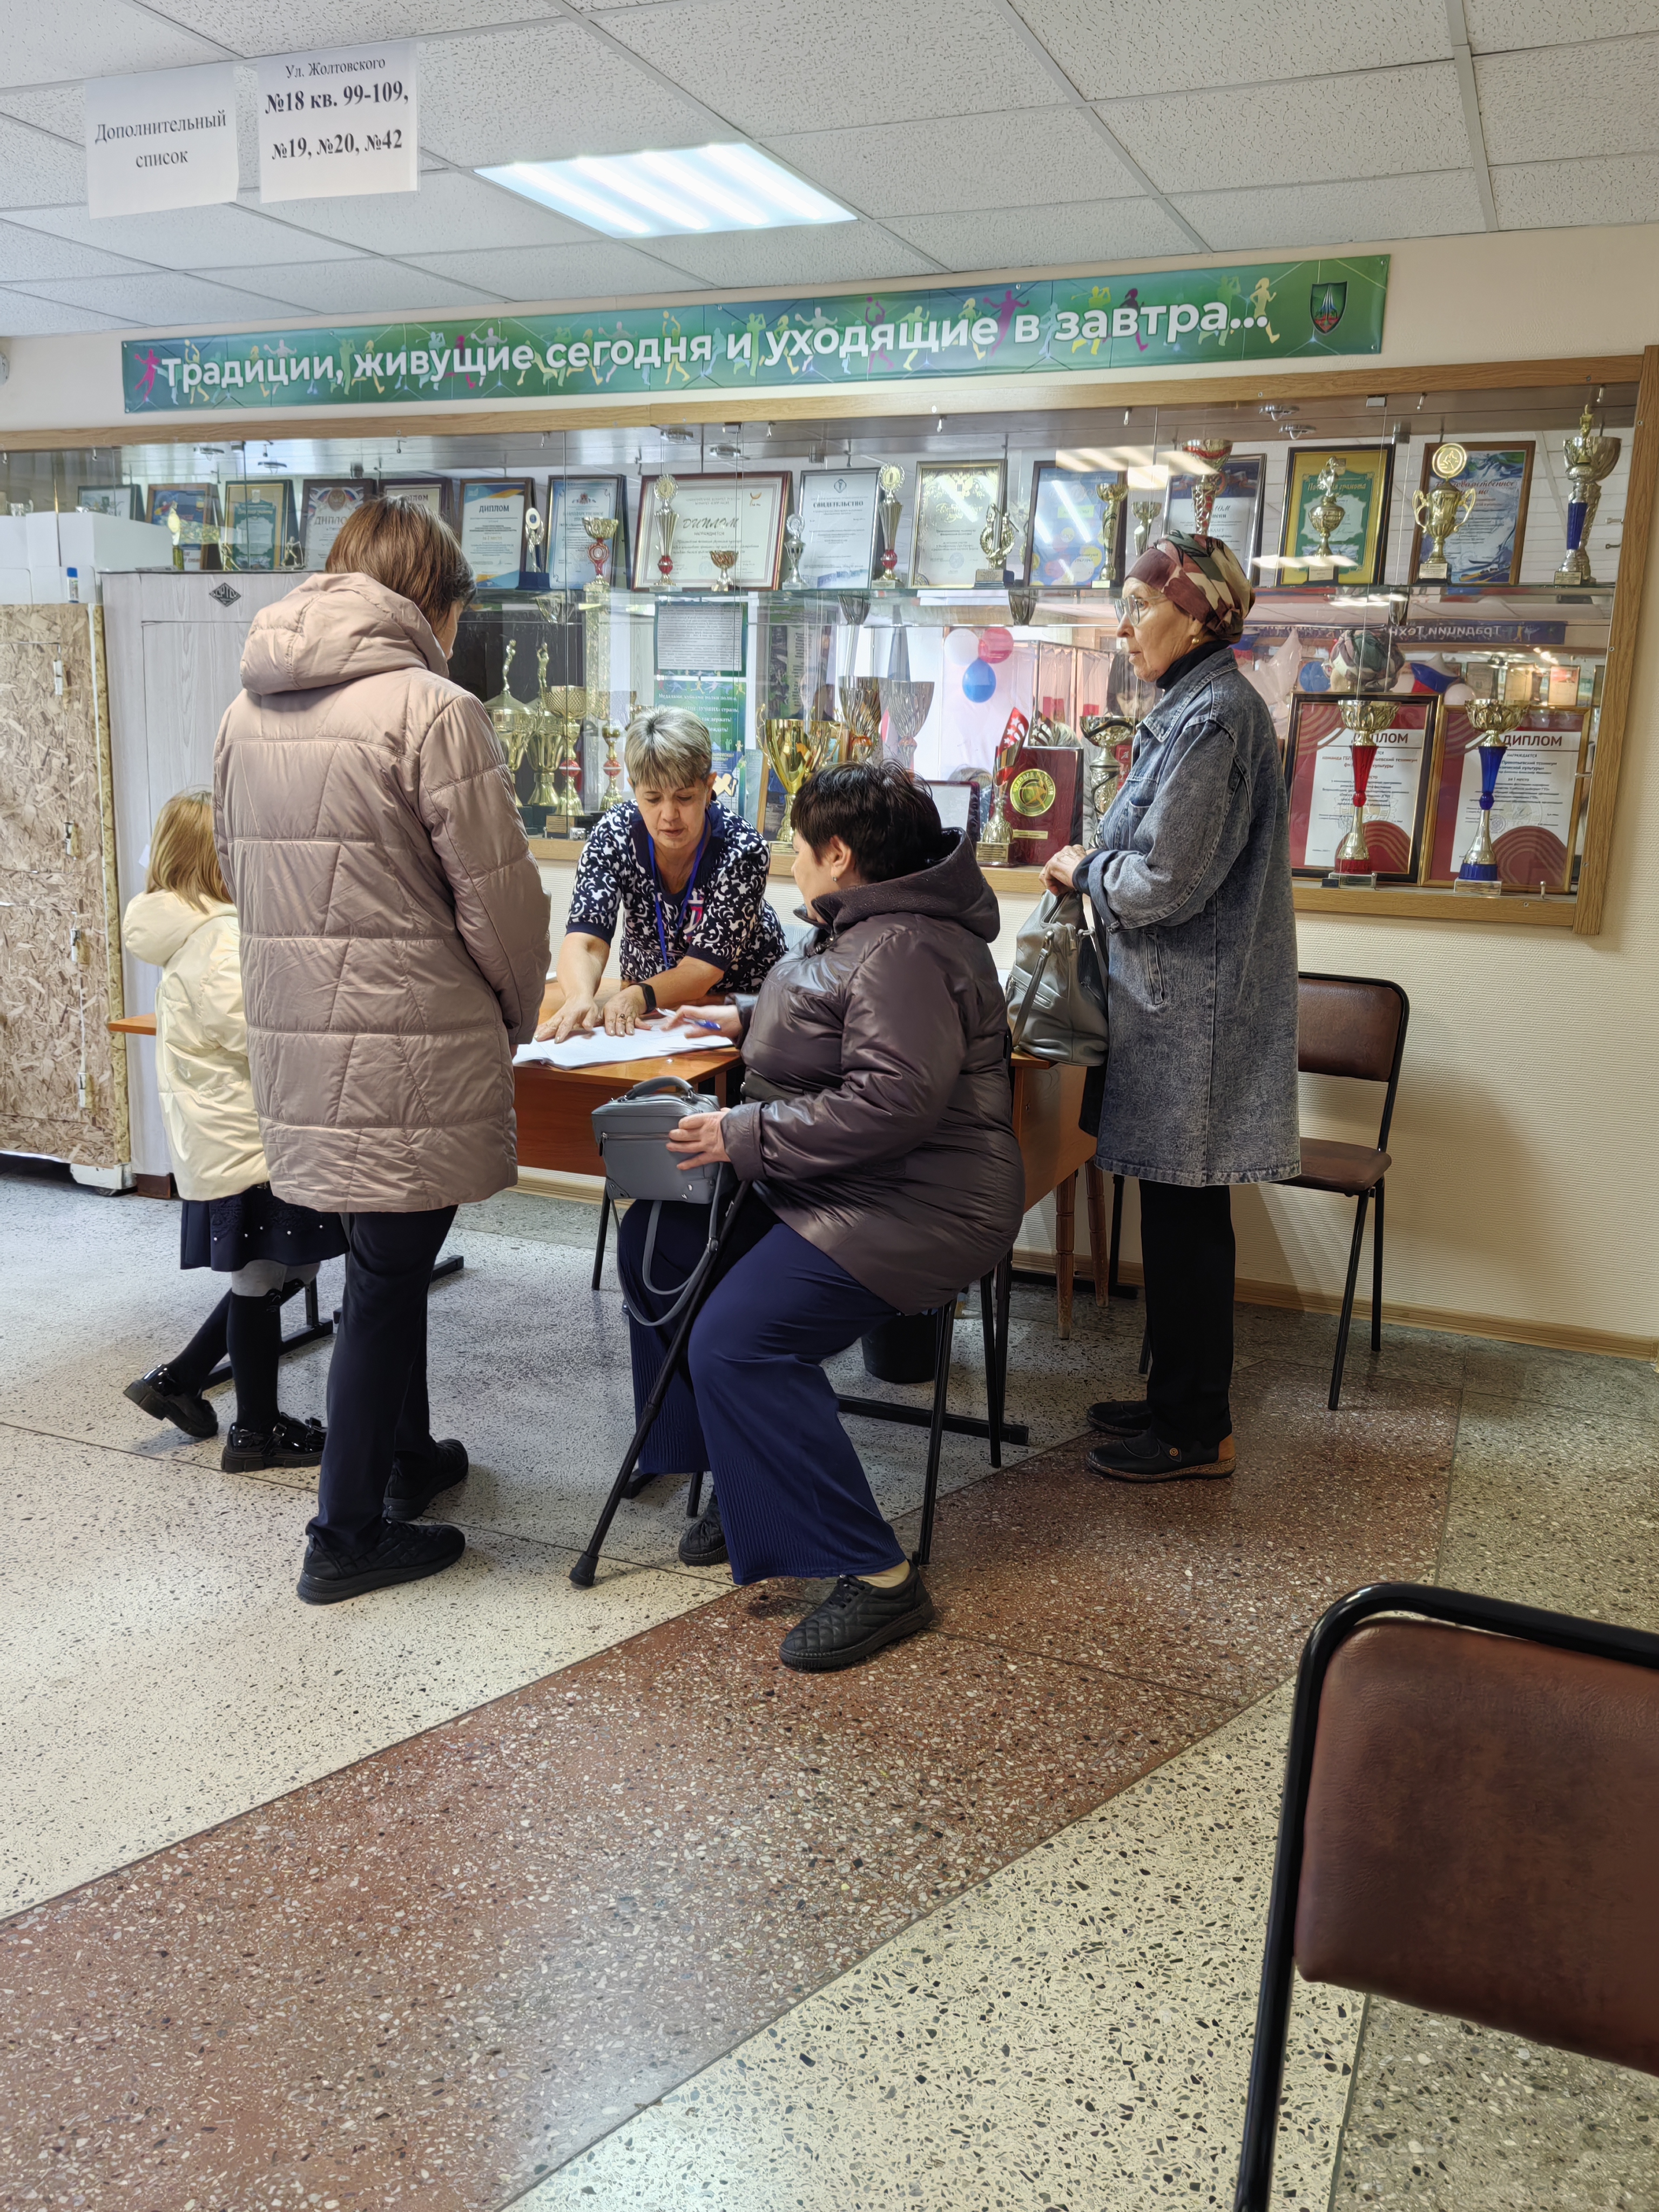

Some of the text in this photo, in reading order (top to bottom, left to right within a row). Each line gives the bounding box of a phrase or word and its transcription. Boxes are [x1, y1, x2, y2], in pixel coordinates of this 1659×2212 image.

[286, 57, 386, 78] Ул. Жолтовского
[265, 81, 409, 113] №18 кв. 99-109,
[95, 110, 227, 144] Дополнительный
[272, 129, 402, 160] №19, №20, №42
[136, 150, 188, 168] список
[162, 301, 1269, 393] Традиции, живущие сегодня и уходящие в завтра...
[479, 505, 509, 513] ДИПЛОМ
[314, 516, 348, 525] ДИПЛО
[1503, 735, 1562, 746] ДИПЛОМ
